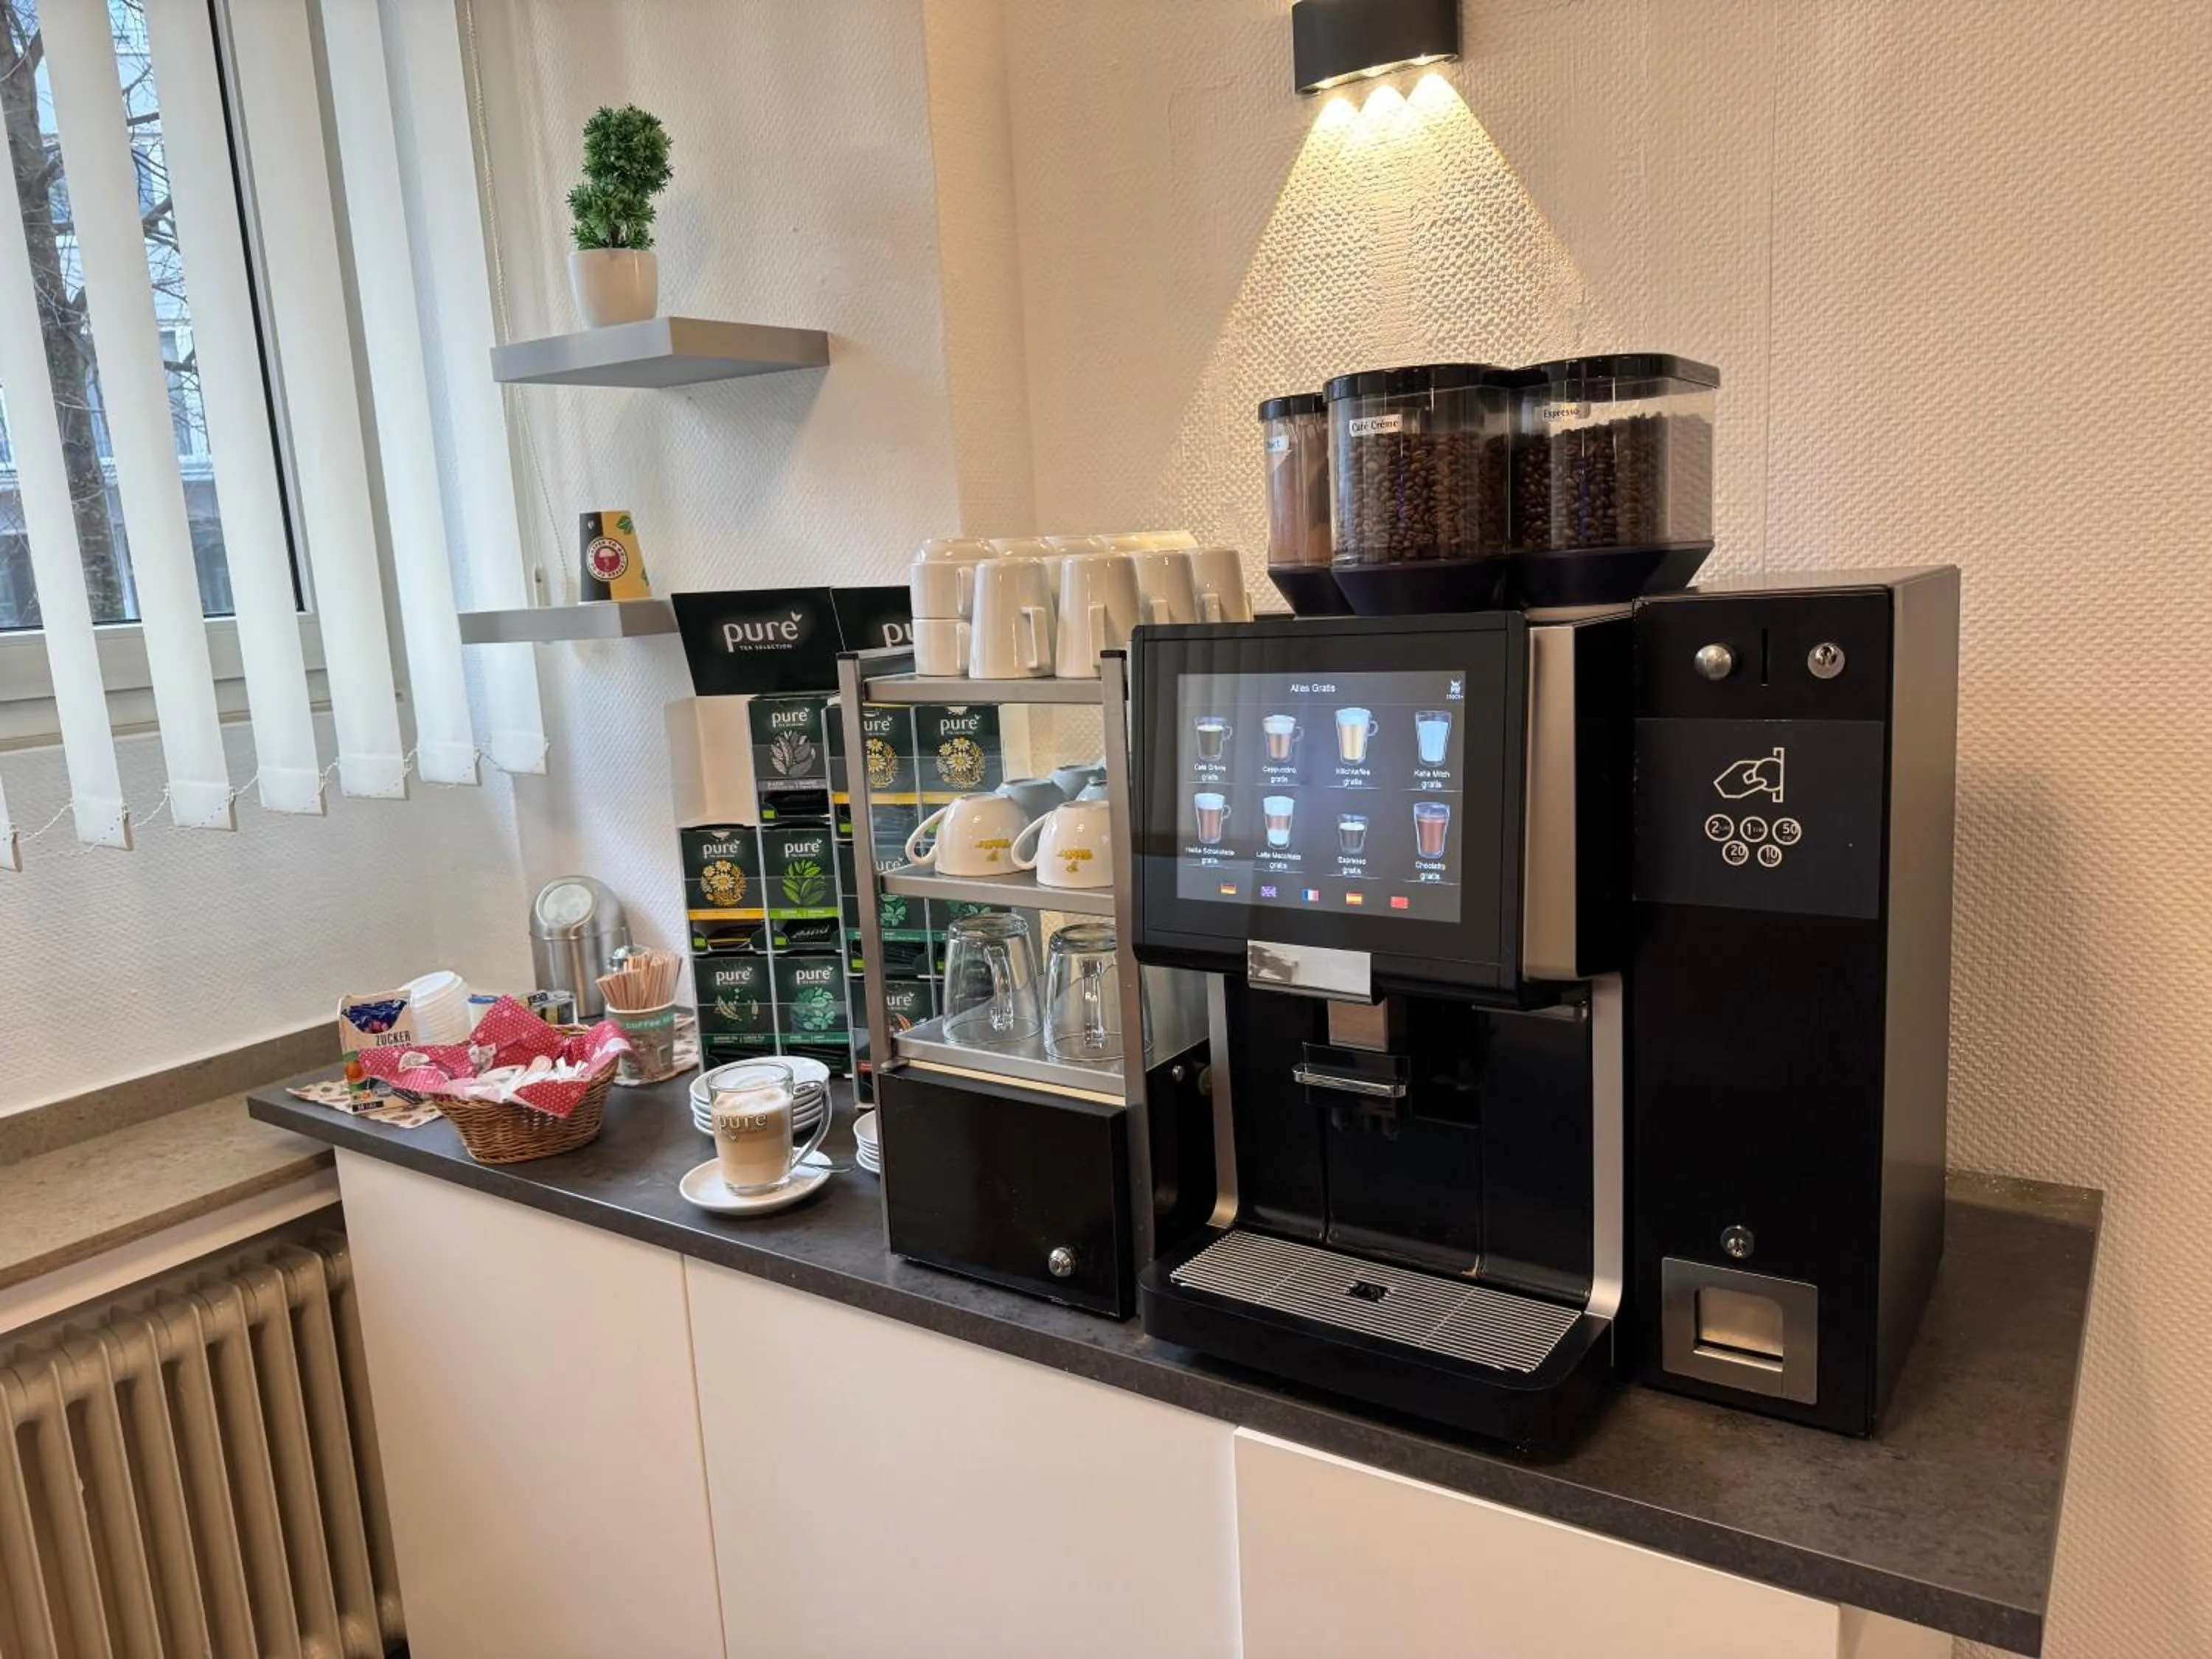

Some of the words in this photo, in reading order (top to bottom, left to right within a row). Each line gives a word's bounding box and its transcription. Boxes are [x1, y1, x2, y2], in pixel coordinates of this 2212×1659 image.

[1543, 408, 1580, 419] Espresso
[1352, 420, 1368, 433] Café
[723, 620, 799, 653] pure
[1312, 684, 1336, 692] Gratis
[771, 711, 808, 728] pure
[863, 720, 890, 731] ure
[940, 718, 978, 736] pure
[1201, 773, 1219, 782] gratis
[1343, 778, 1363, 786] gratis
[1421, 780, 1442, 790] gratis
[1711, 821, 1719, 834] 2
[1746, 822, 1752, 835] 1
[1782, 823, 1798, 835] 50
[703, 842, 738, 859] pure
[784, 841, 820, 858] pure
[1730, 844, 1745, 856] 20
[1765, 846, 1778, 859] 10
[875, 860, 900, 871] ure
[715, 970, 751, 986] pure
[796, 968, 831, 986] pure
[886, 995, 912, 1006] ure
[375, 1030, 411, 1046] ZUCKER
[717, 1113, 768, 1132] pure
